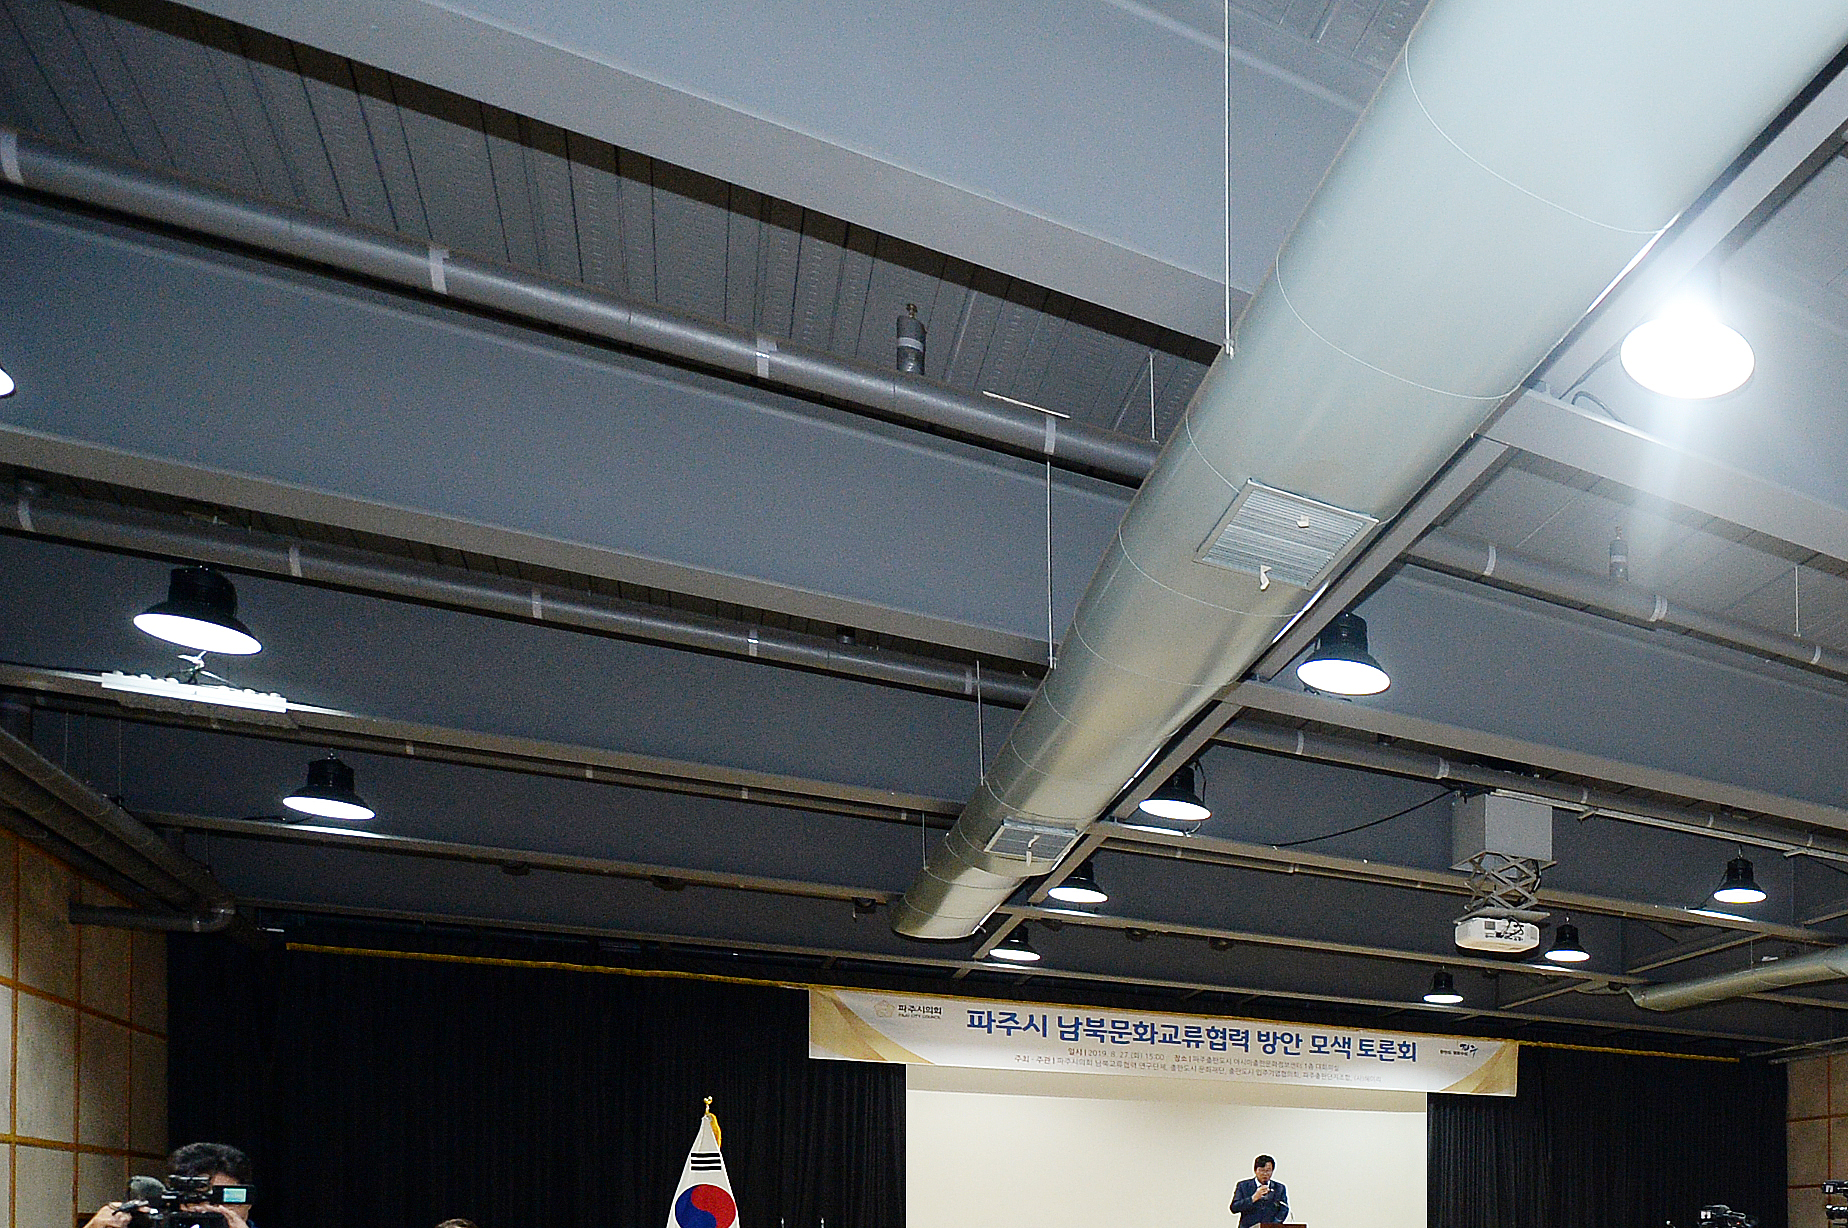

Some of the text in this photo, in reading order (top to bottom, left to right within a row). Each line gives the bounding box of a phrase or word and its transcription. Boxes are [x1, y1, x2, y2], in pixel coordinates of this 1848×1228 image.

[898, 1004, 942, 1015] 파주시의회
[966, 1009, 1418, 1063] 파주시 남북문화교류협력 방안 모색 토론회
[1174, 1054, 1187, 1062] 장소
